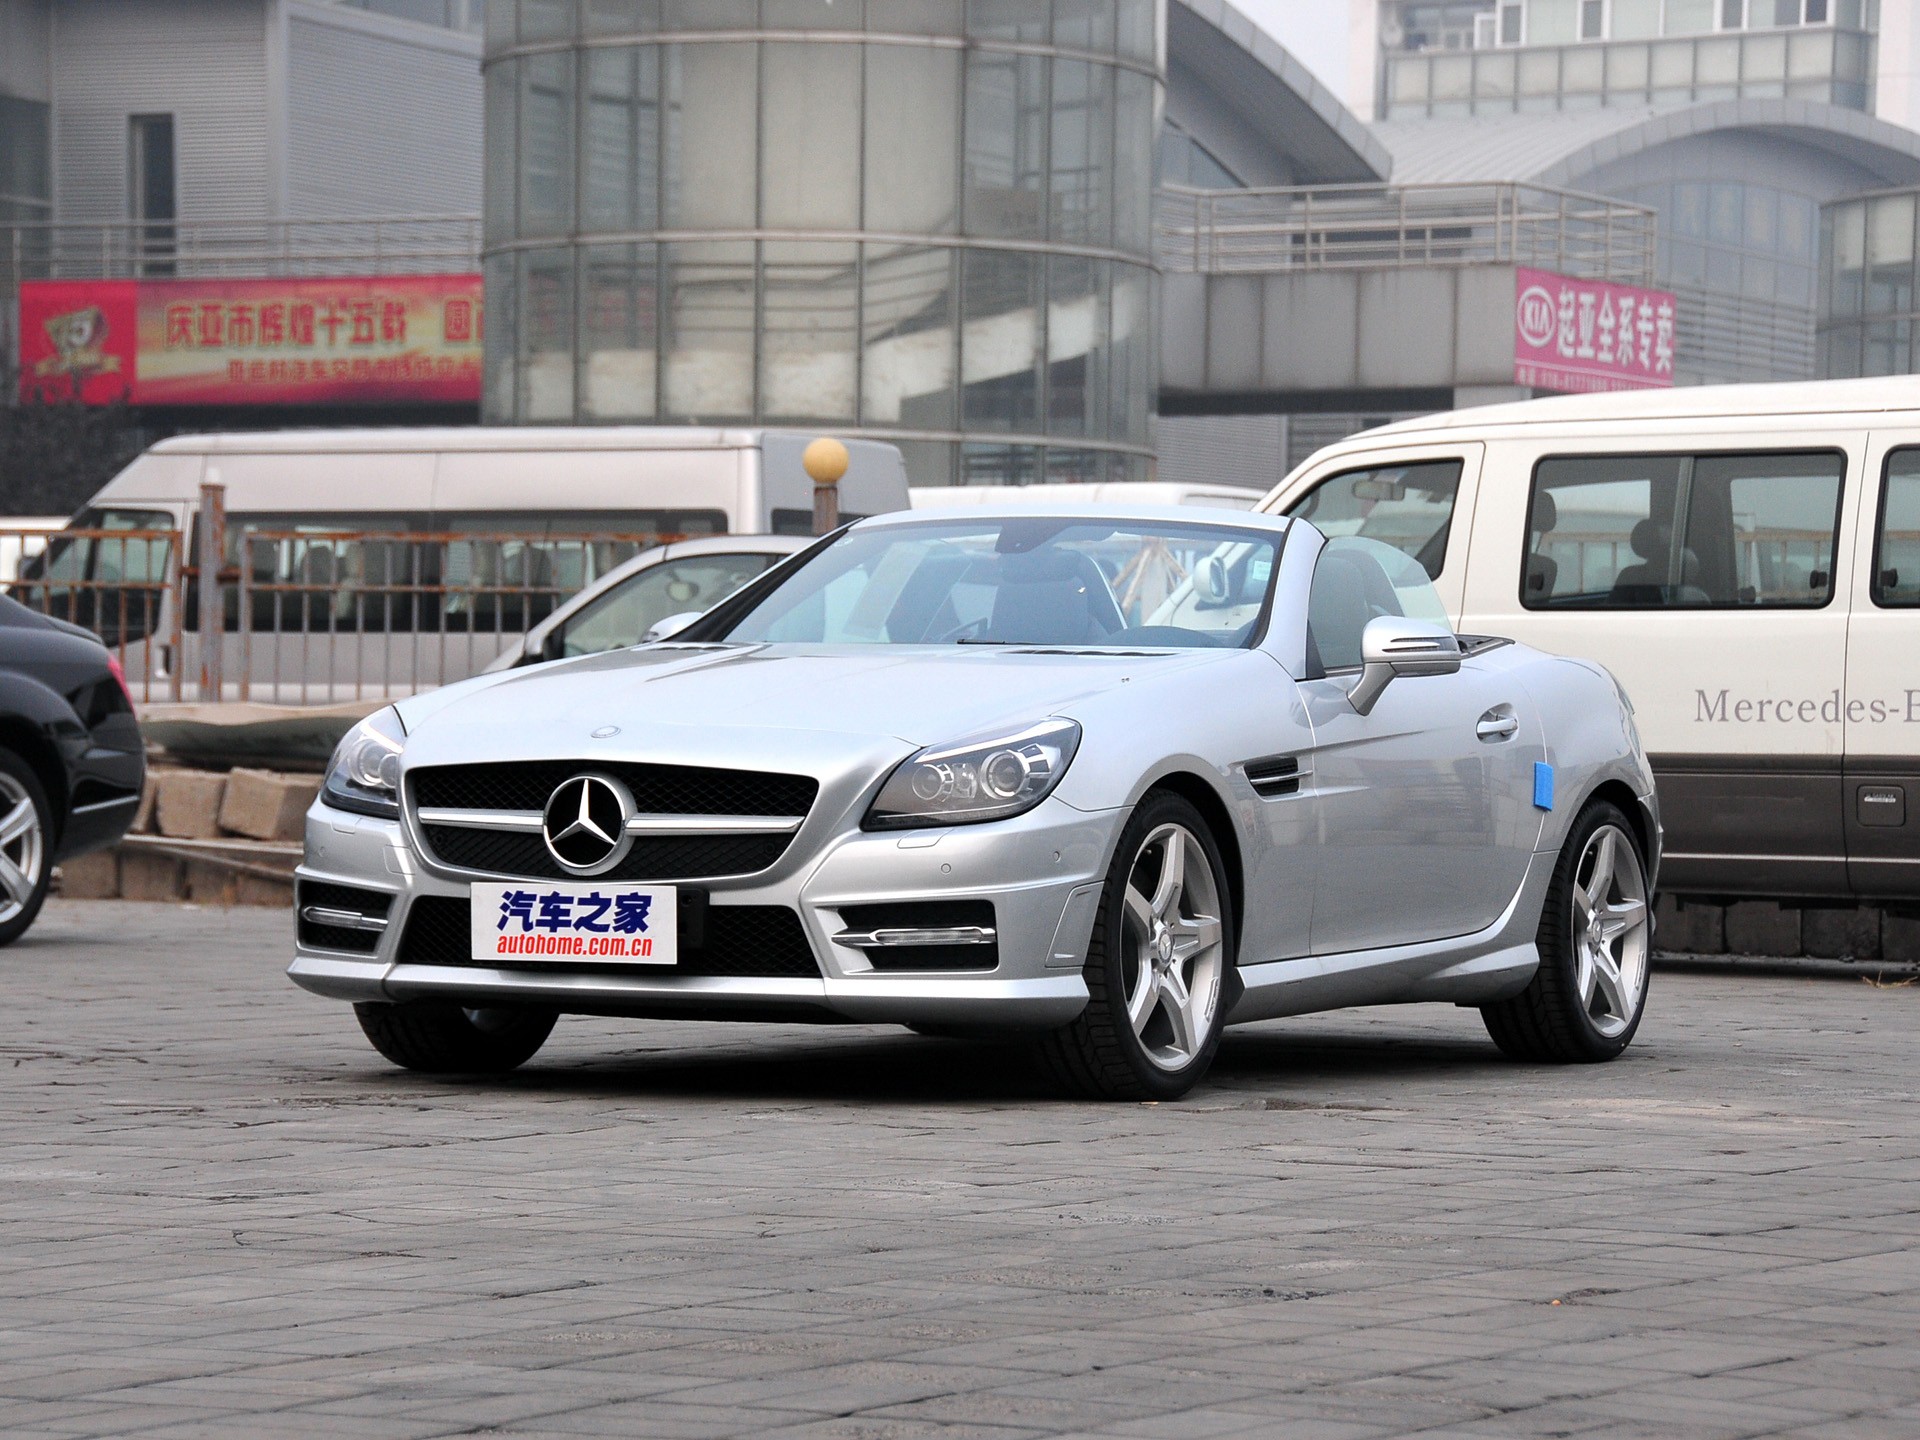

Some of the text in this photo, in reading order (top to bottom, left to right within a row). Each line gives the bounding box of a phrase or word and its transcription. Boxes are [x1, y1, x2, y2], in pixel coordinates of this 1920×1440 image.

[1524, 285, 1673, 373] KIA 起亚全系专卖
[497, 890, 652, 933] 汽车之家
[497, 934, 652, 957] autohome.com.cn
